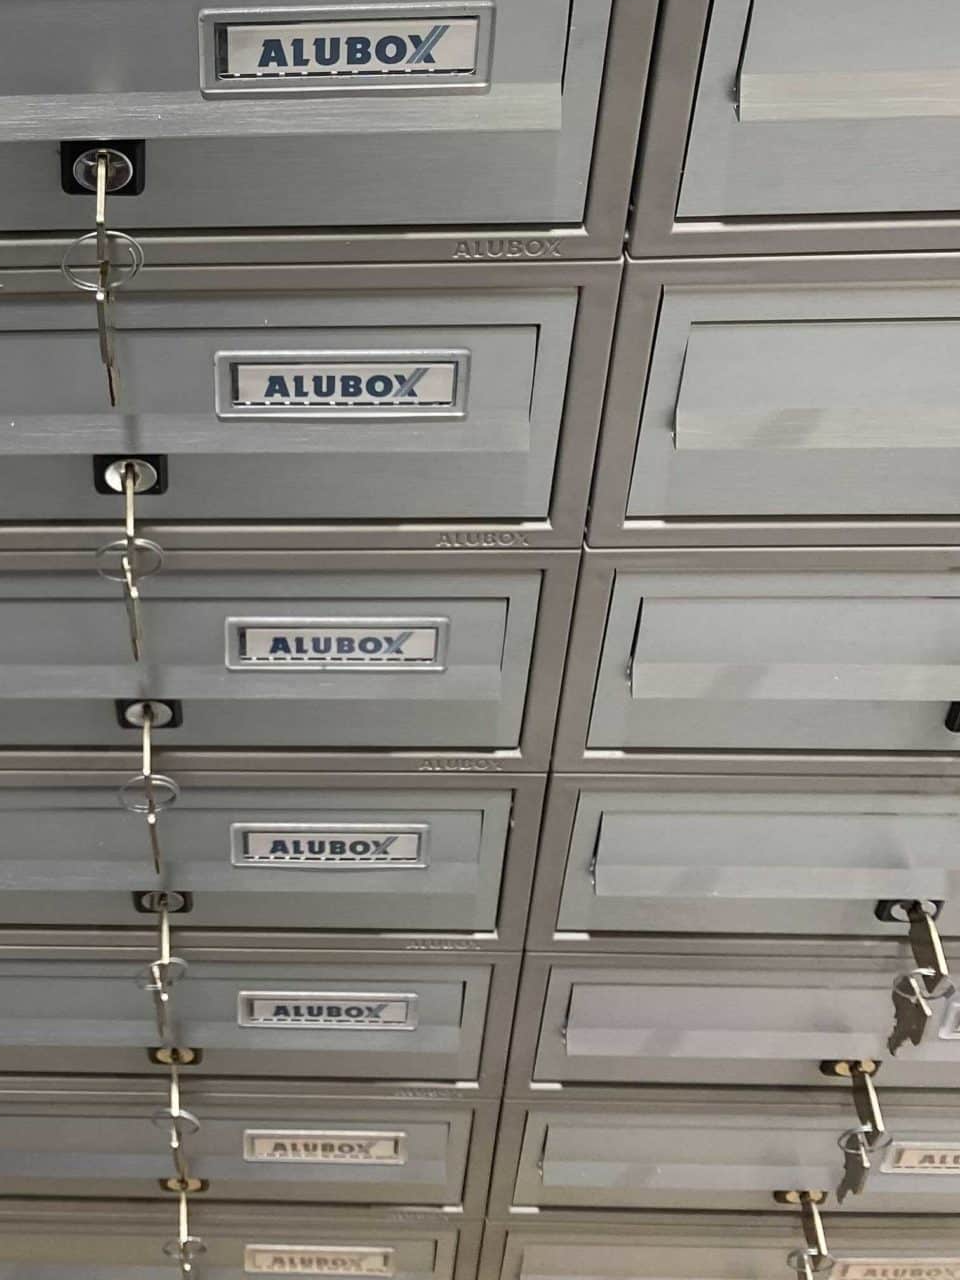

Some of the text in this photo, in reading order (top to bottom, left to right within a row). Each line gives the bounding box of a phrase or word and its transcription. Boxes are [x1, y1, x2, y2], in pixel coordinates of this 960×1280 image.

[257, 25, 449, 67] ALUBOX
[452, 239, 561, 258] ALUBOX
[264, 368, 429, 398] ALUBOX
[436, 531, 529, 548] ALUBOX
[269, 632, 413, 655] ALUBOX
[269, 837, 399, 857] ALUBOX
[273, 1003, 390, 1019] ALUBOX
[272, 1141, 376, 1154] ALUBOX
[271, 1256, 364, 1269] ALUBOX
